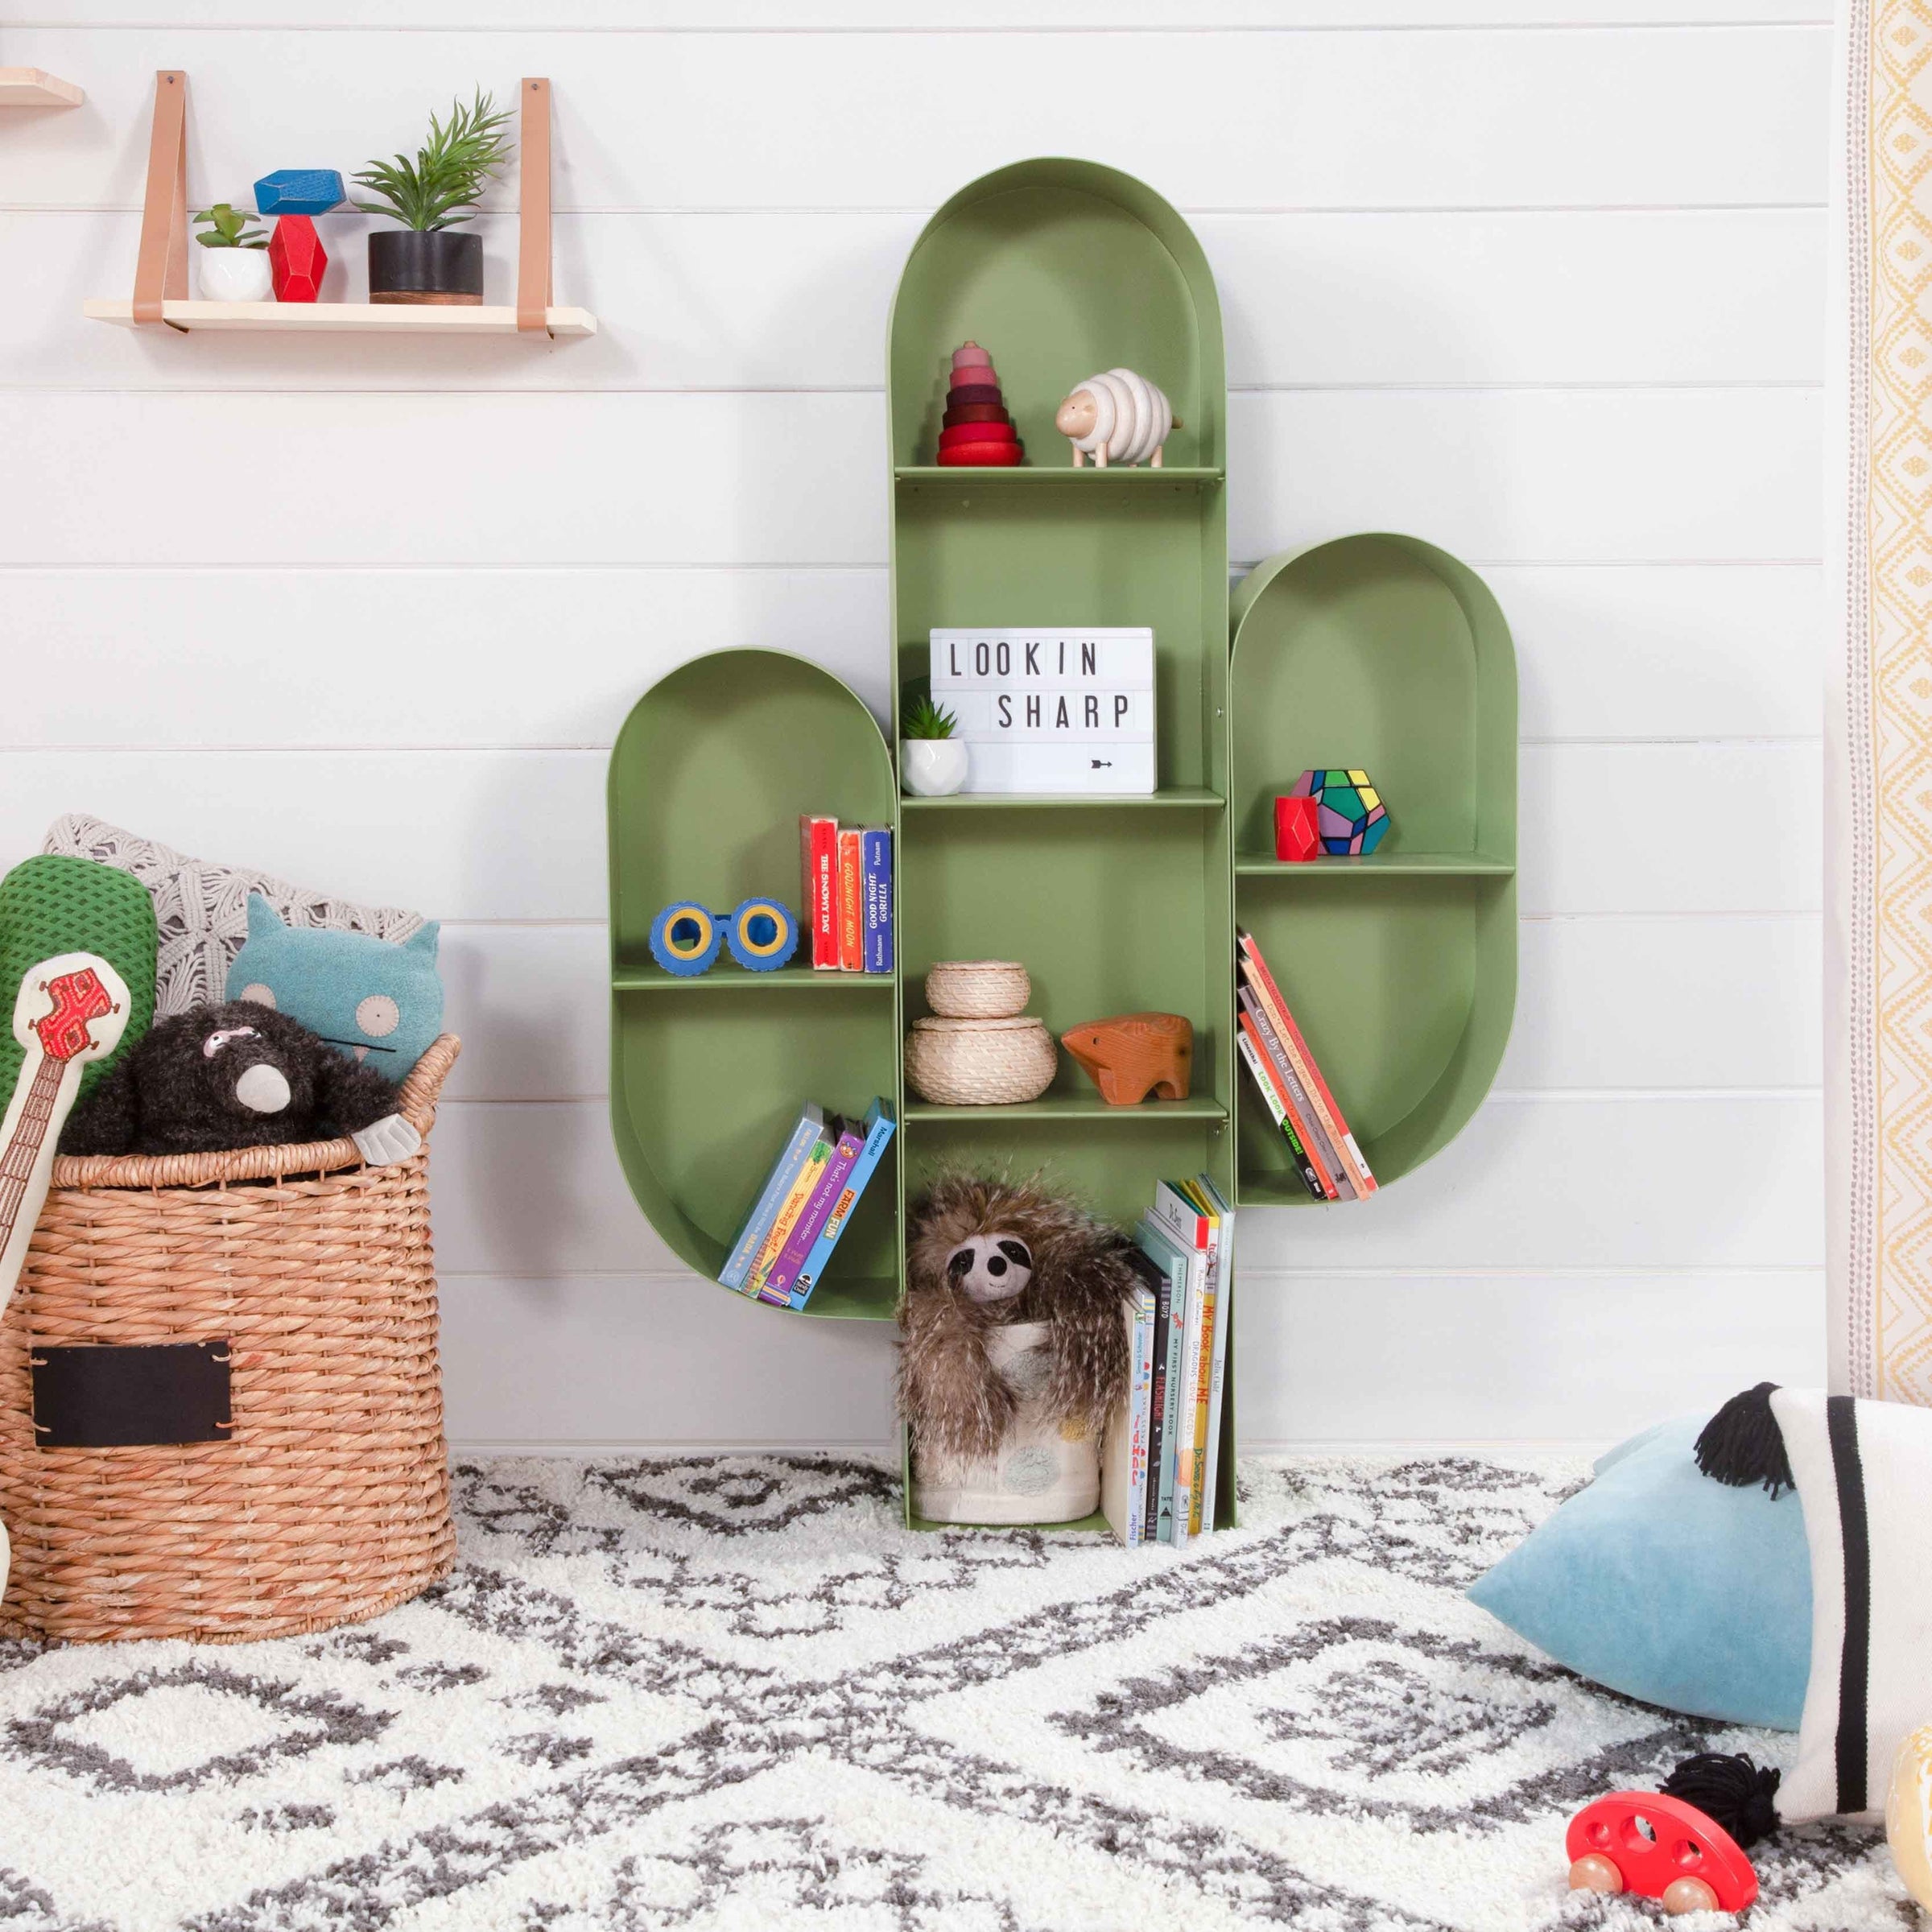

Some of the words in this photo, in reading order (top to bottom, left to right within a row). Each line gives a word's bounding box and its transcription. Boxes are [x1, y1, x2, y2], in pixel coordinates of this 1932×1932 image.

[951, 642, 1096, 675] LOOKIN
[998, 695, 1128, 728] SHARP
[820, 854, 828, 872] THE
[820, 873, 829, 912] SNOWY
[843, 862, 856, 916] GOODNIGHT
[869, 903, 877, 929] GOOD
[879, 884, 888, 923] GORILLA
[821, 914, 829, 934] DAY
[844, 919, 855, 947] MOON
[1254, 1008, 1273, 1038] Crazy
[1268, 1037, 1281, 1053] By
[1275, 1051, 1290, 1068] the
[1286, 1069, 1305, 1103] Letters
[1278, 1027, 1290, 1042] Let
[1287, 1044, 1298, 1059] the
[1257, 1070, 1272, 1092] LOOK
[1269, 1094, 1283, 1116] LOOK
[1280, 1118, 1303, 1155] OUTSIDE!
[867, 1125, 887, 1157] Marshall
[829, 1158, 847, 1184] That's
[812, 1195, 826, 1210] my
[821, 1182, 834, 1197] not
[833, 1188, 855, 1219] FARM
[778, 1190, 804, 1227] Dancing
[766, 1226, 786, 1253] Feet!
[824, 1216, 841, 1239] FUN
[1160, 1300, 1169, 1319] BOYD
[1173, 1338, 1178, 1349] MY
[1190, 1340, 1199, 1377] DRAGONS
[1198, 1355, 1210, 1384] about
[1188, 1381, 1196, 1404] LOVE
[1196, 1387, 1209, 1405] ME
[1193, 1447, 1203, 1459] Dr.
